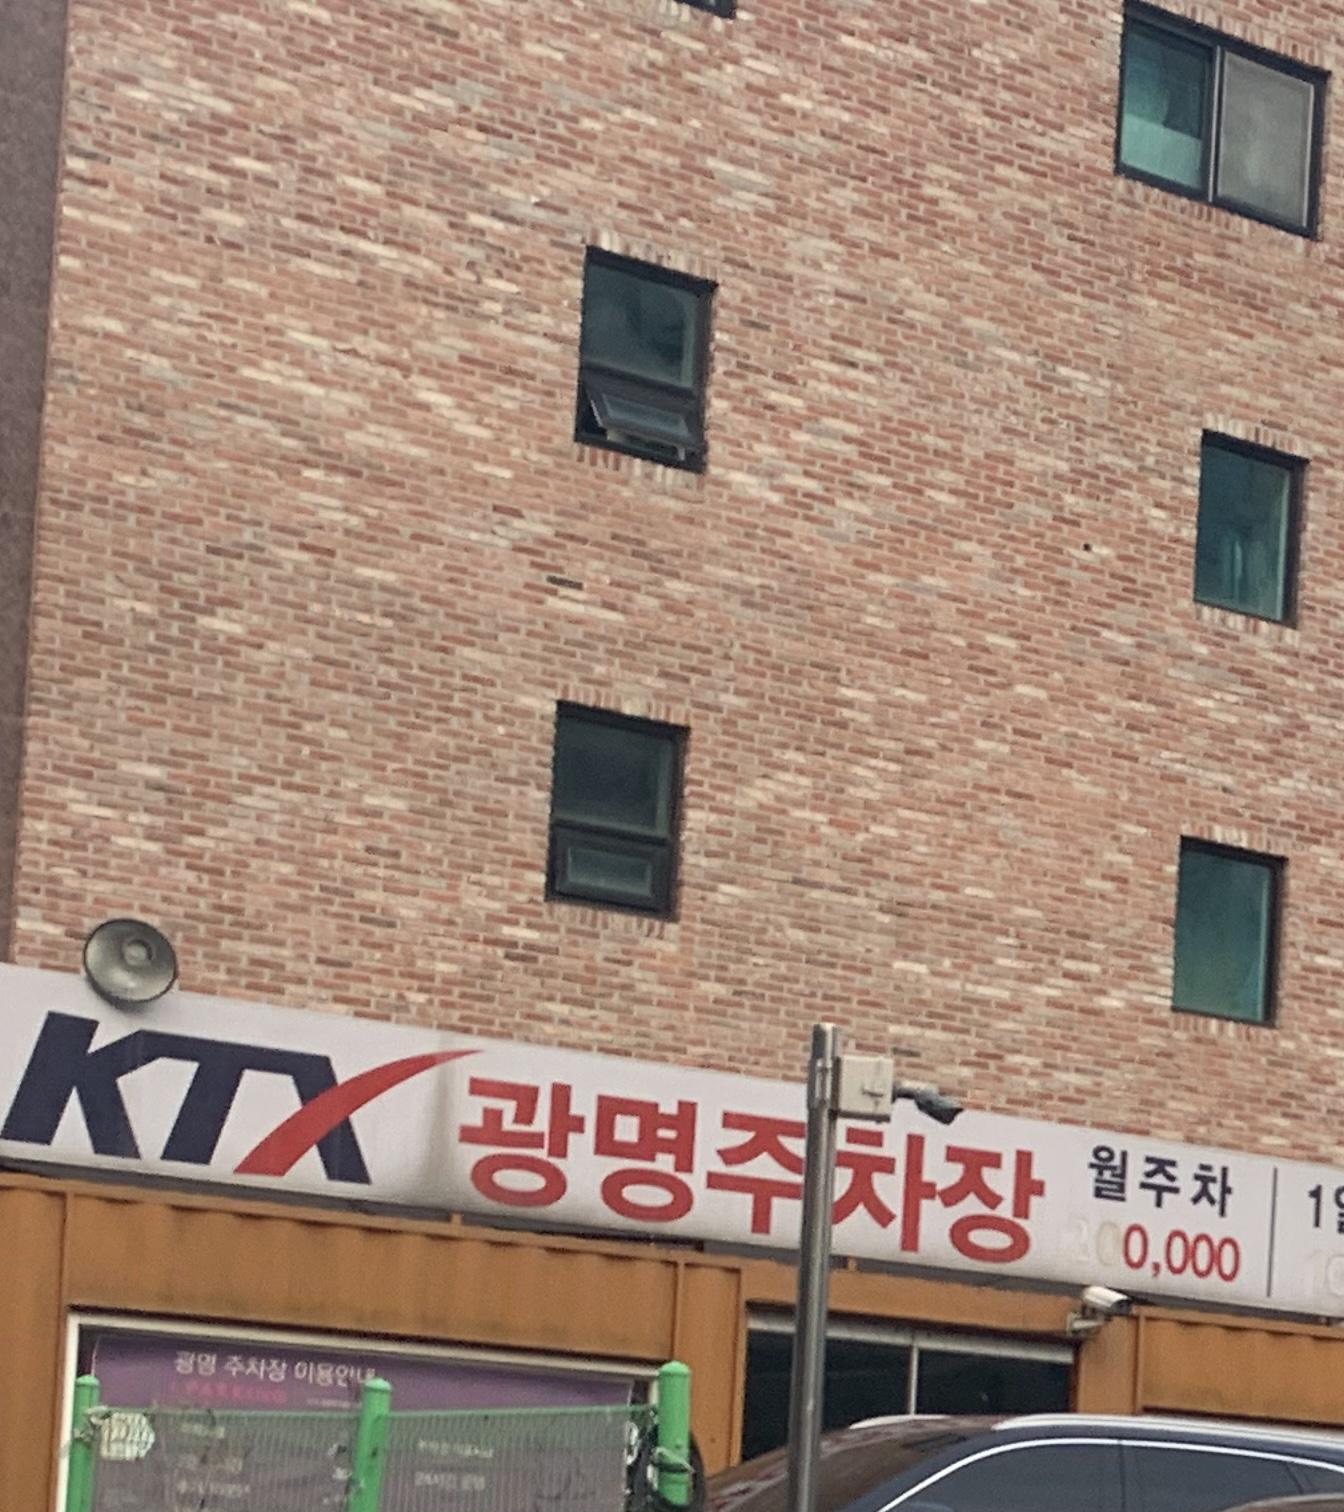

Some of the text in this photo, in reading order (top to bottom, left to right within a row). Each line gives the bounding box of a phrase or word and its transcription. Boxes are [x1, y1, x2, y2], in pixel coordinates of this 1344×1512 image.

[0, 1010, 485, 1185] KTX
[458, 1074, 1047, 1264] 광명주차장
[1088, 1144, 1233, 1217] 월주차
[224, 1355, 289, 1383] 주차장
